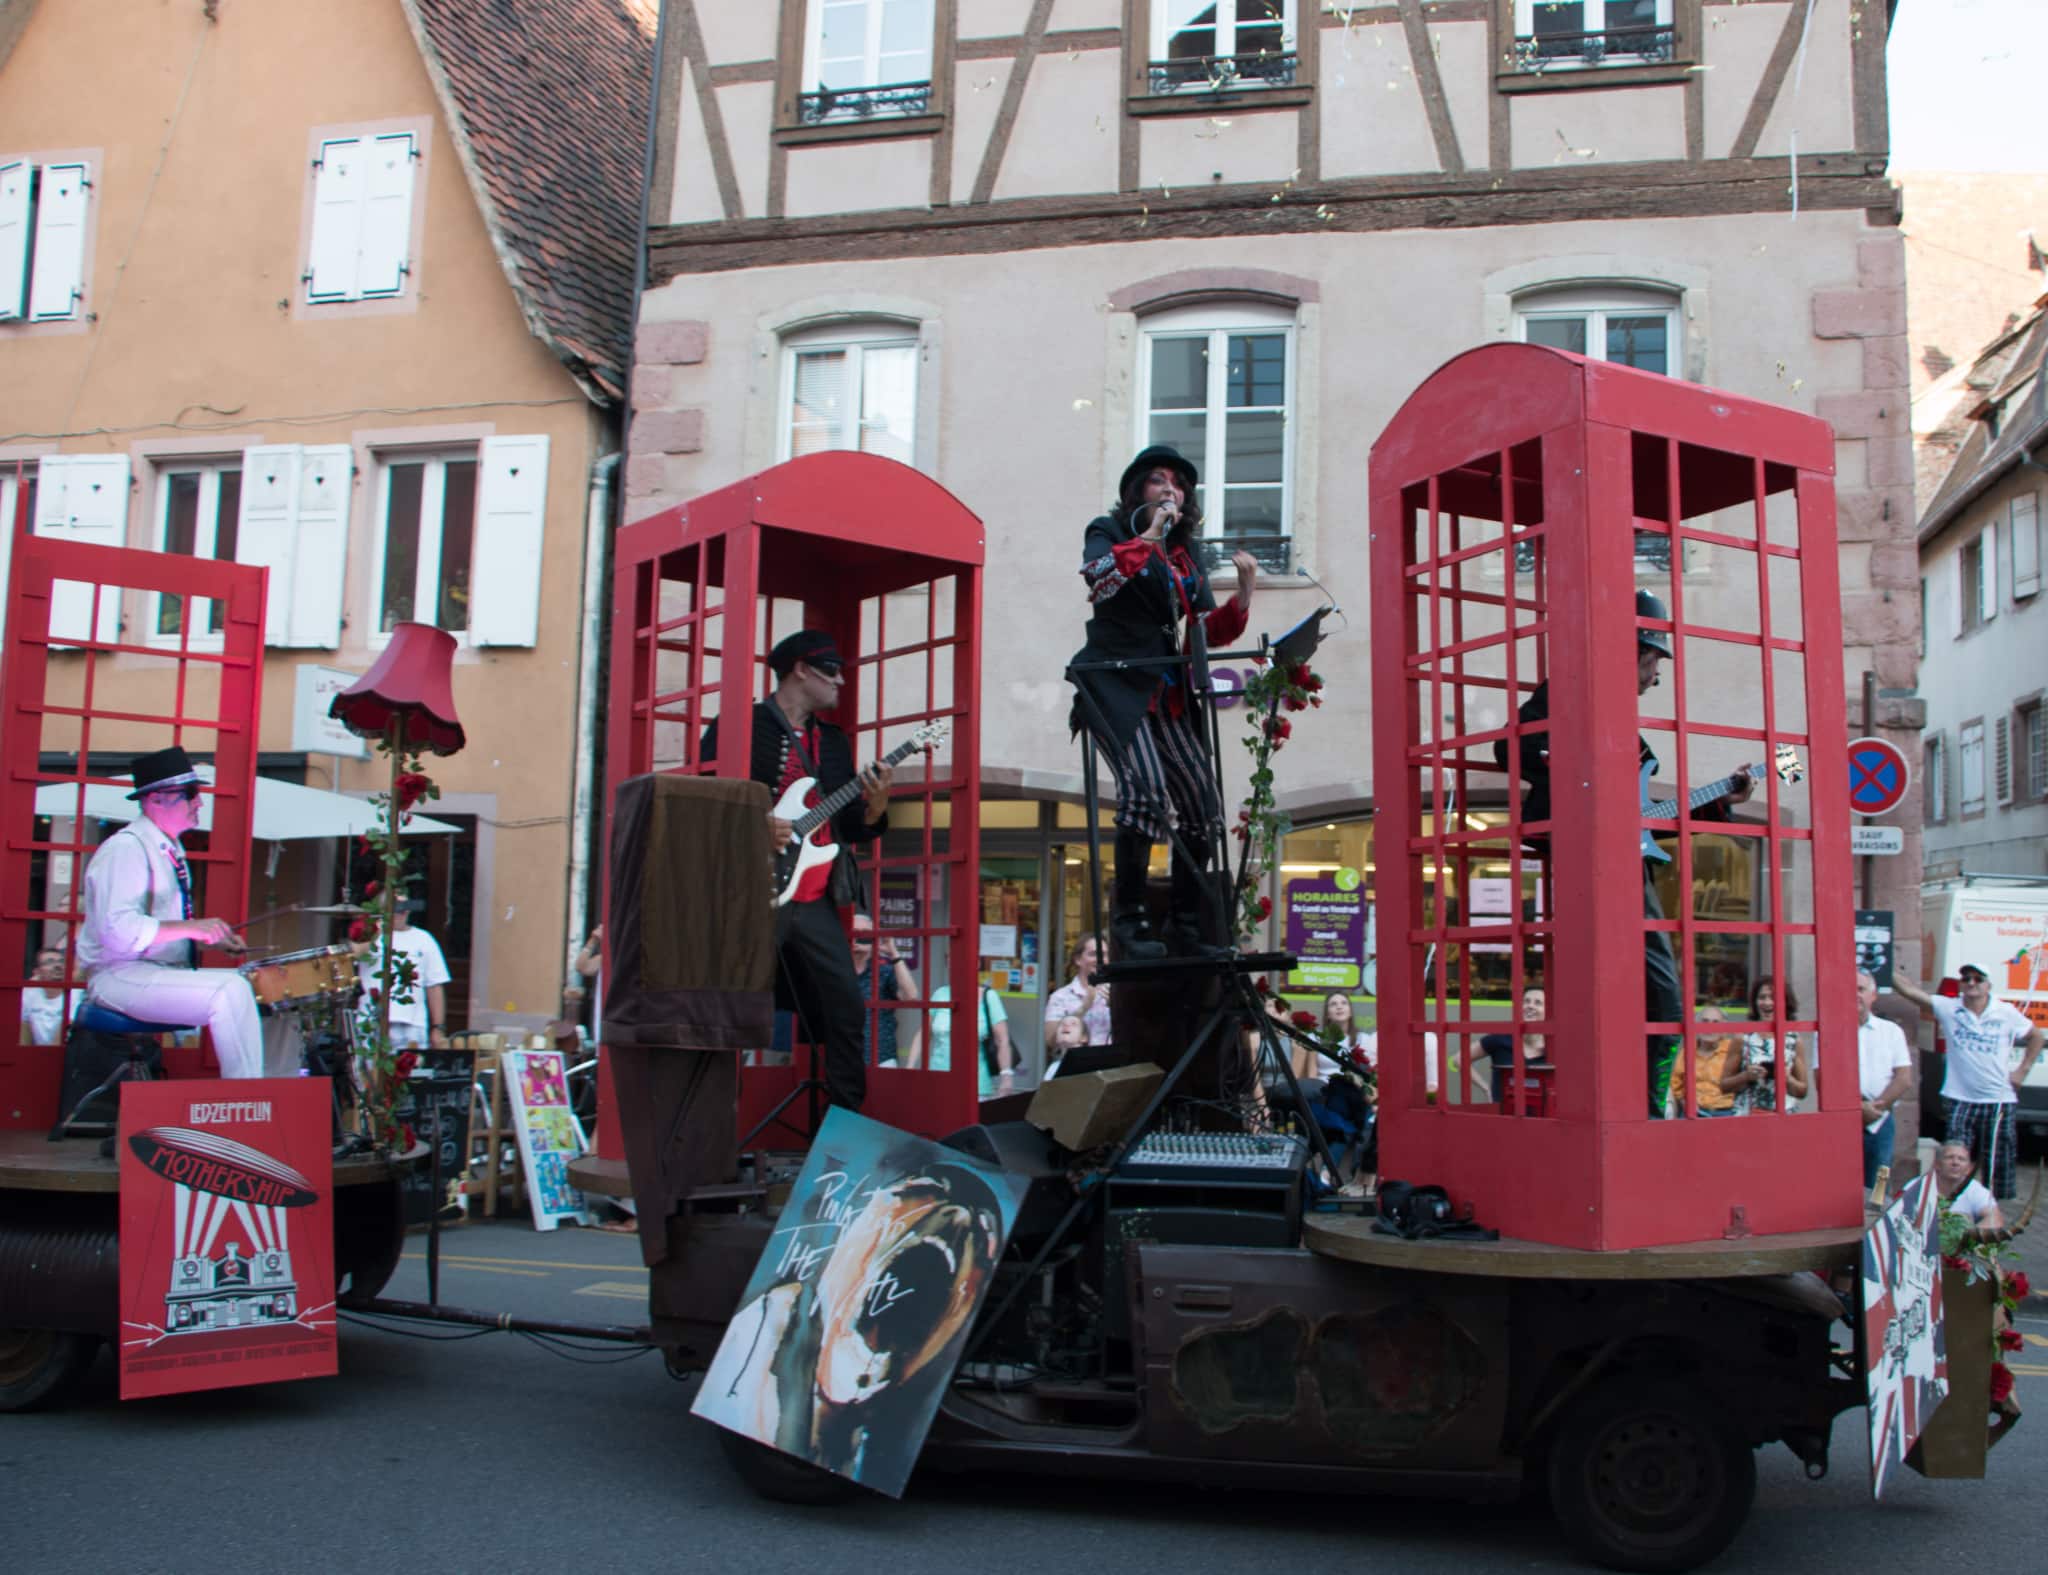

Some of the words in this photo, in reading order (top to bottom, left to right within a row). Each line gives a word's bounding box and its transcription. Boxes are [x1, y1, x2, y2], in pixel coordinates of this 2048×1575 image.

[1859, 831, 1884, 840] SAUF
[1293, 892, 1359, 903] HORAIRES
[150, 1147, 296, 1205] MOTHERSHIP
[775, 1222, 838, 1280] THE
